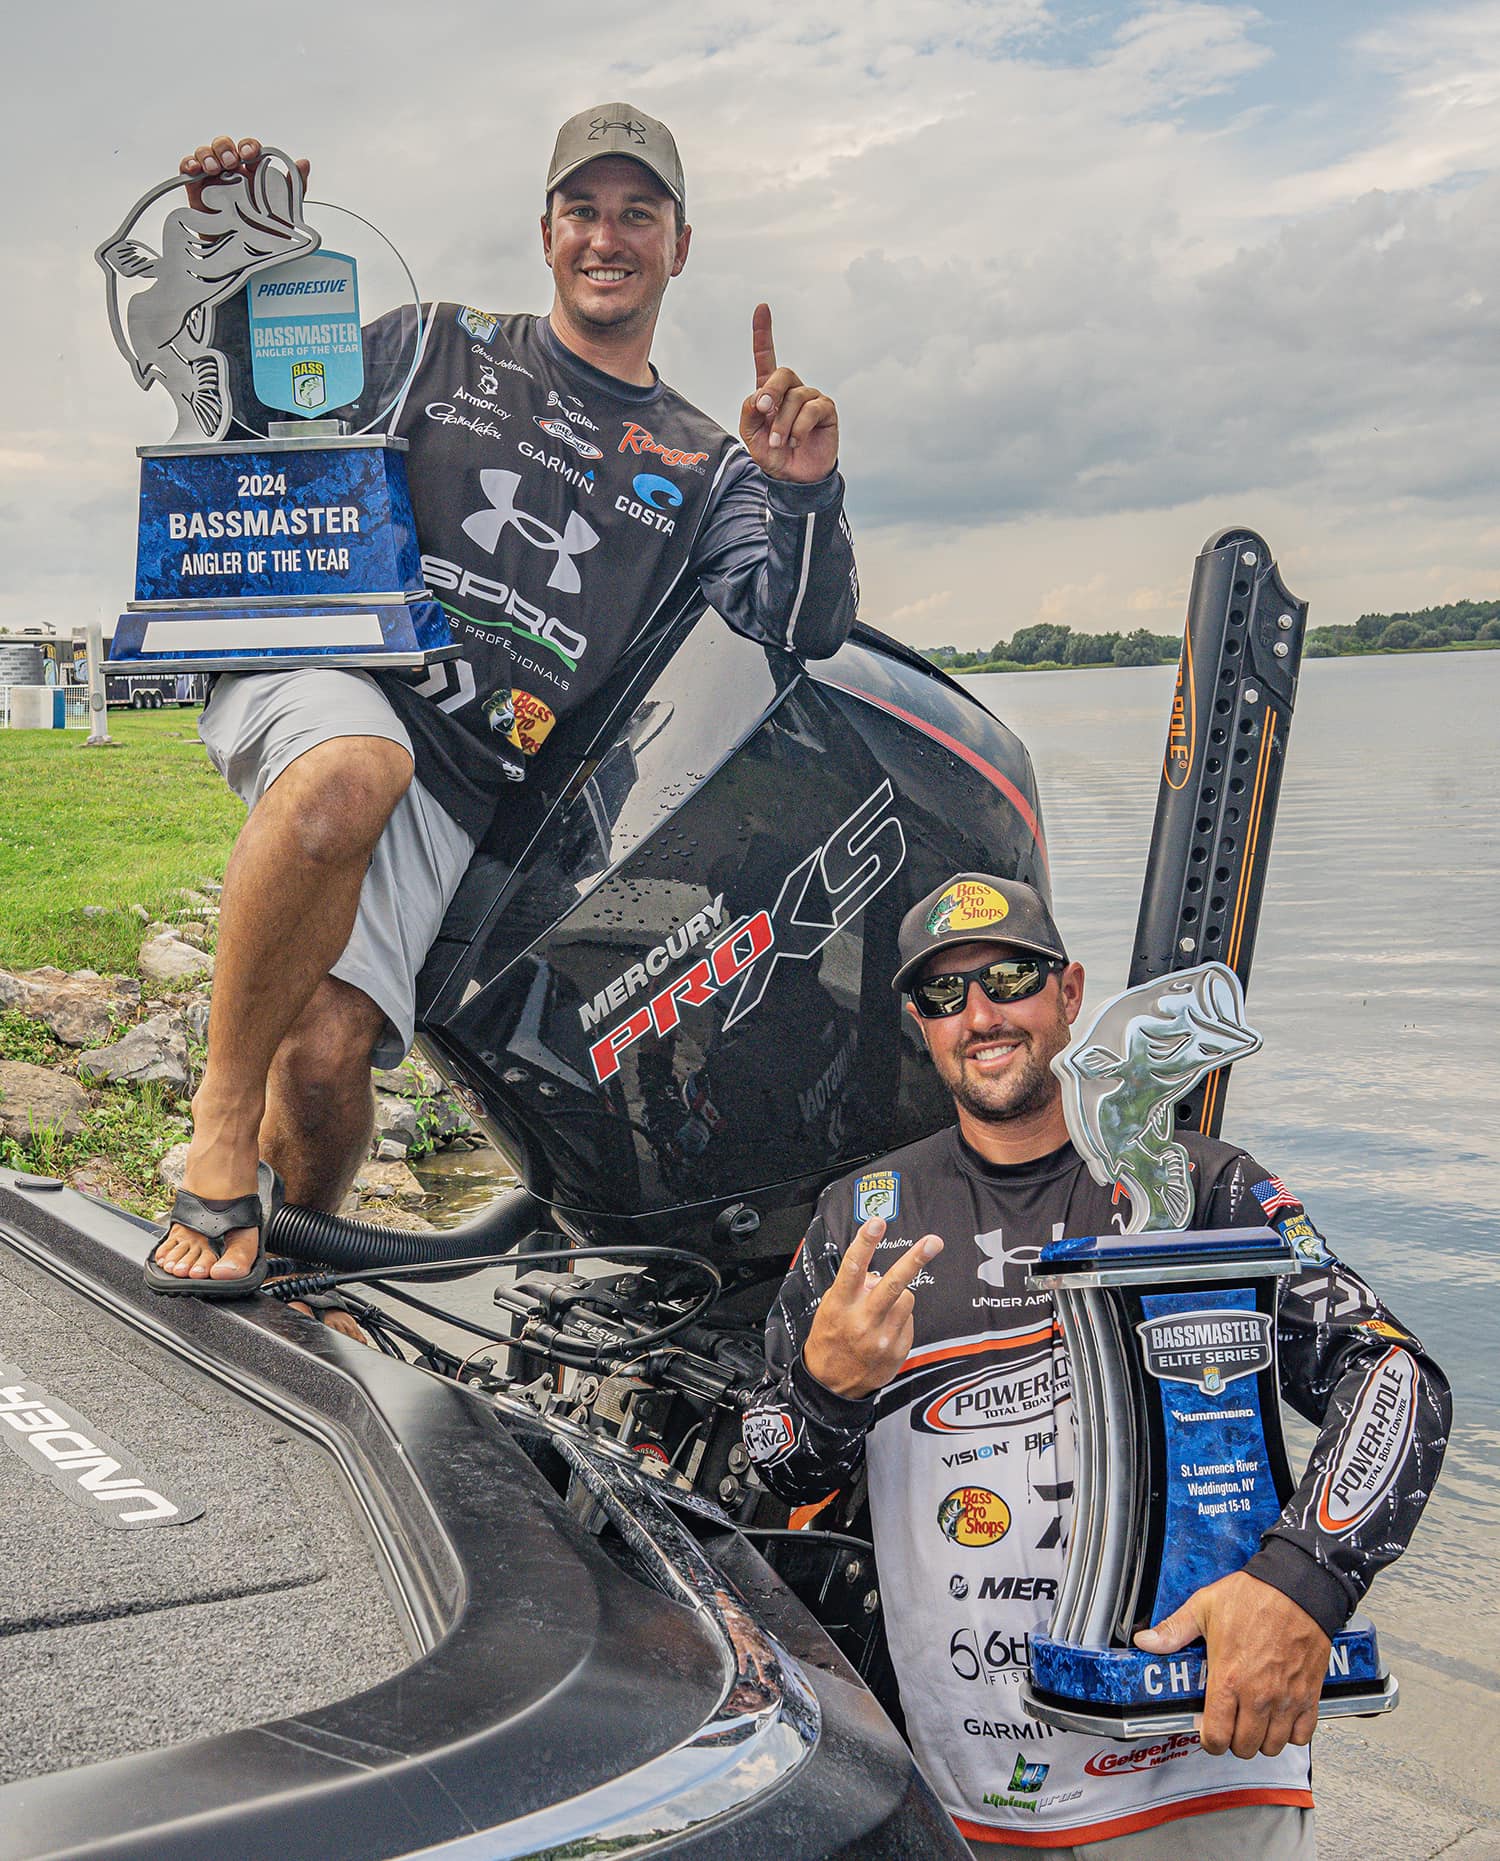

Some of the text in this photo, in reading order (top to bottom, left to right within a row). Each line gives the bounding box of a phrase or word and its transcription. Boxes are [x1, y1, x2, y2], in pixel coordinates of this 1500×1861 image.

[257, 279, 347, 297] PROGRESSIVE
[254, 323, 358, 347] BASSMASTER
[256, 343, 359, 358] ANGLER OF THE YEAR
[293, 363, 323, 377] BASS
[618, 421, 710, 467] Ranger
[518, 441, 594, 496] GARMIN
[238, 474, 287, 497] 2024
[169, 506, 360, 540] BASSMASTER
[614, 495, 676, 536] COSTA
[181, 548, 349, 576] ANGLER OF THE YEAR
[420, 554, 587, 659] SPRO
[513, 691, 553, 723] Bass
[956, 883, 991, 898] Bass
[960, 896, 985, 909] Pro
[961, 906, 1004, 921] Shops
[578, 893, 724, 1032] MERCURY
[589, 909, 775, 1085] PRO
[859, 1179, 896, 1193] BASS
[875, 1237, 914, 1250] ohnston
[972, 1292, 1053, 1308] UNDER ARM
[1151, 1320, 1261, 1350] BASSMASTER
[1158, 1348, 1260, 1367] ELITE SERIES
[983, 1394, 1052, 1419] TOTAL BOAT
[1177, 1409, 1256, 1422] HUMMINBIRD
[1024, 1432, 1057, 1459] Bla
[1332, 1366, 1404, 1506] POWER-POLE
[941, 1441, 1009, 1468] VISION
[1362, 1465, 1385, 1491] TOTAL
[1378, 1437, 1395, 1464] BOAT
[1181, 1459, 1258, 1478] St. Lawrence River
[962, 1488, 992, 1505] Bass
[1188, 1479, 1255, 1497] Waddington, NY
[963, 1503, 987, 1519] Pro
[1198, 1500, 1251, 1516] August 15-18
[964, 1517, 1006, 1538] Shops
[978, 1576, 1058, 1601] MER
[1098, 1733, 1201, 1771] GeigerTec
[1149, 1750, 1189, 1767] Marine
